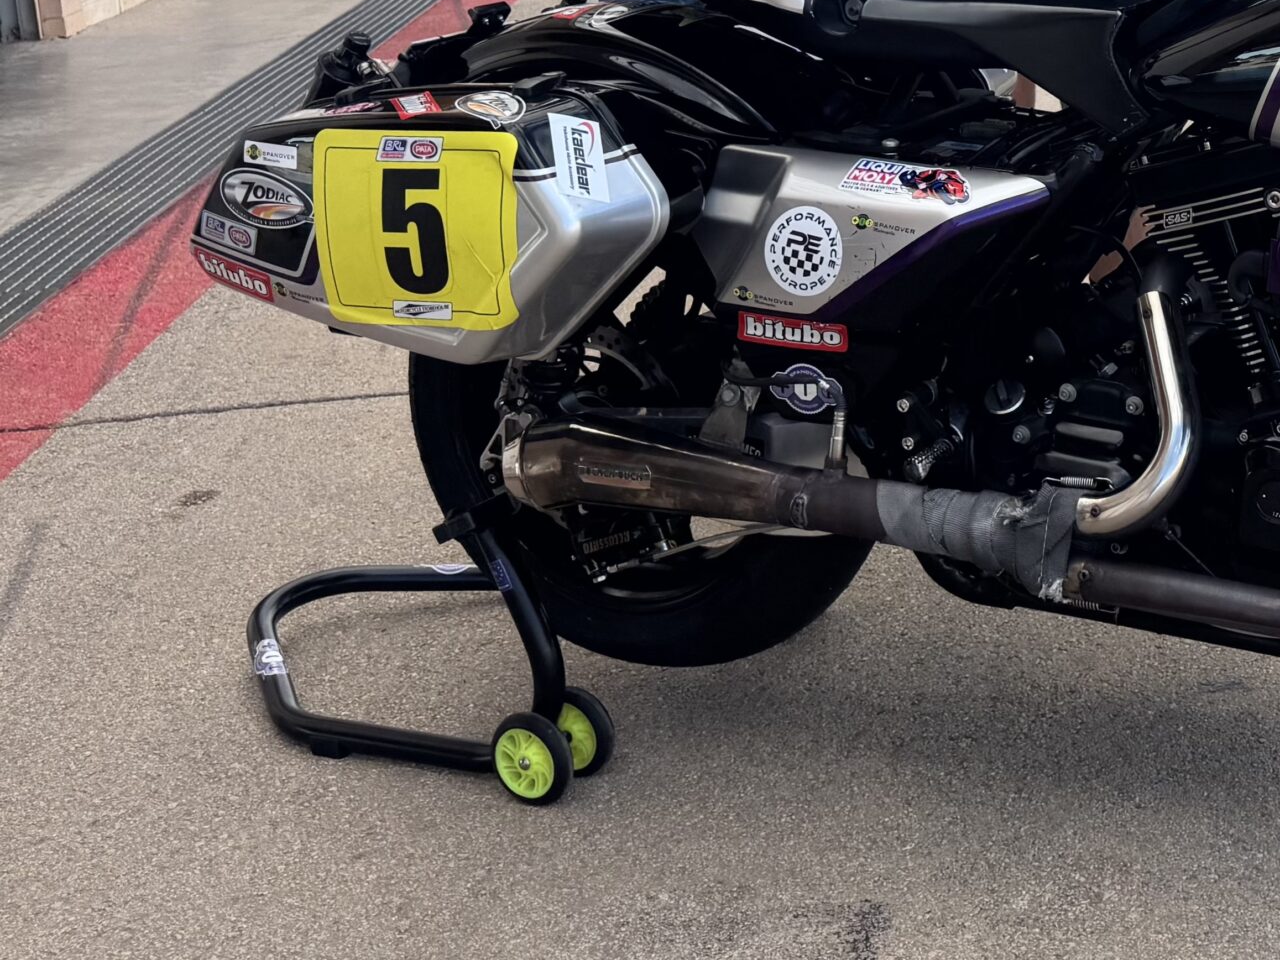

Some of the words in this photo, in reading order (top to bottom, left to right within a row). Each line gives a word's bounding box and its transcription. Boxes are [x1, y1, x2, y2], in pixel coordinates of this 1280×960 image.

[415, 145, 433, 153] PATA
[848, 169, 897, 185] MOLY
[857, 160, 901, 174] LIQUI
[381, 168, 450, 294] 5
[769, 212, 838, 270] PERFORMANCE
[874, 221, 917, 235] SPANOVER
[200, 253, 269, 296] bitubo
[773, 264, 827, 291] EUROPE
[745, 315, 842, 346] bitubo
